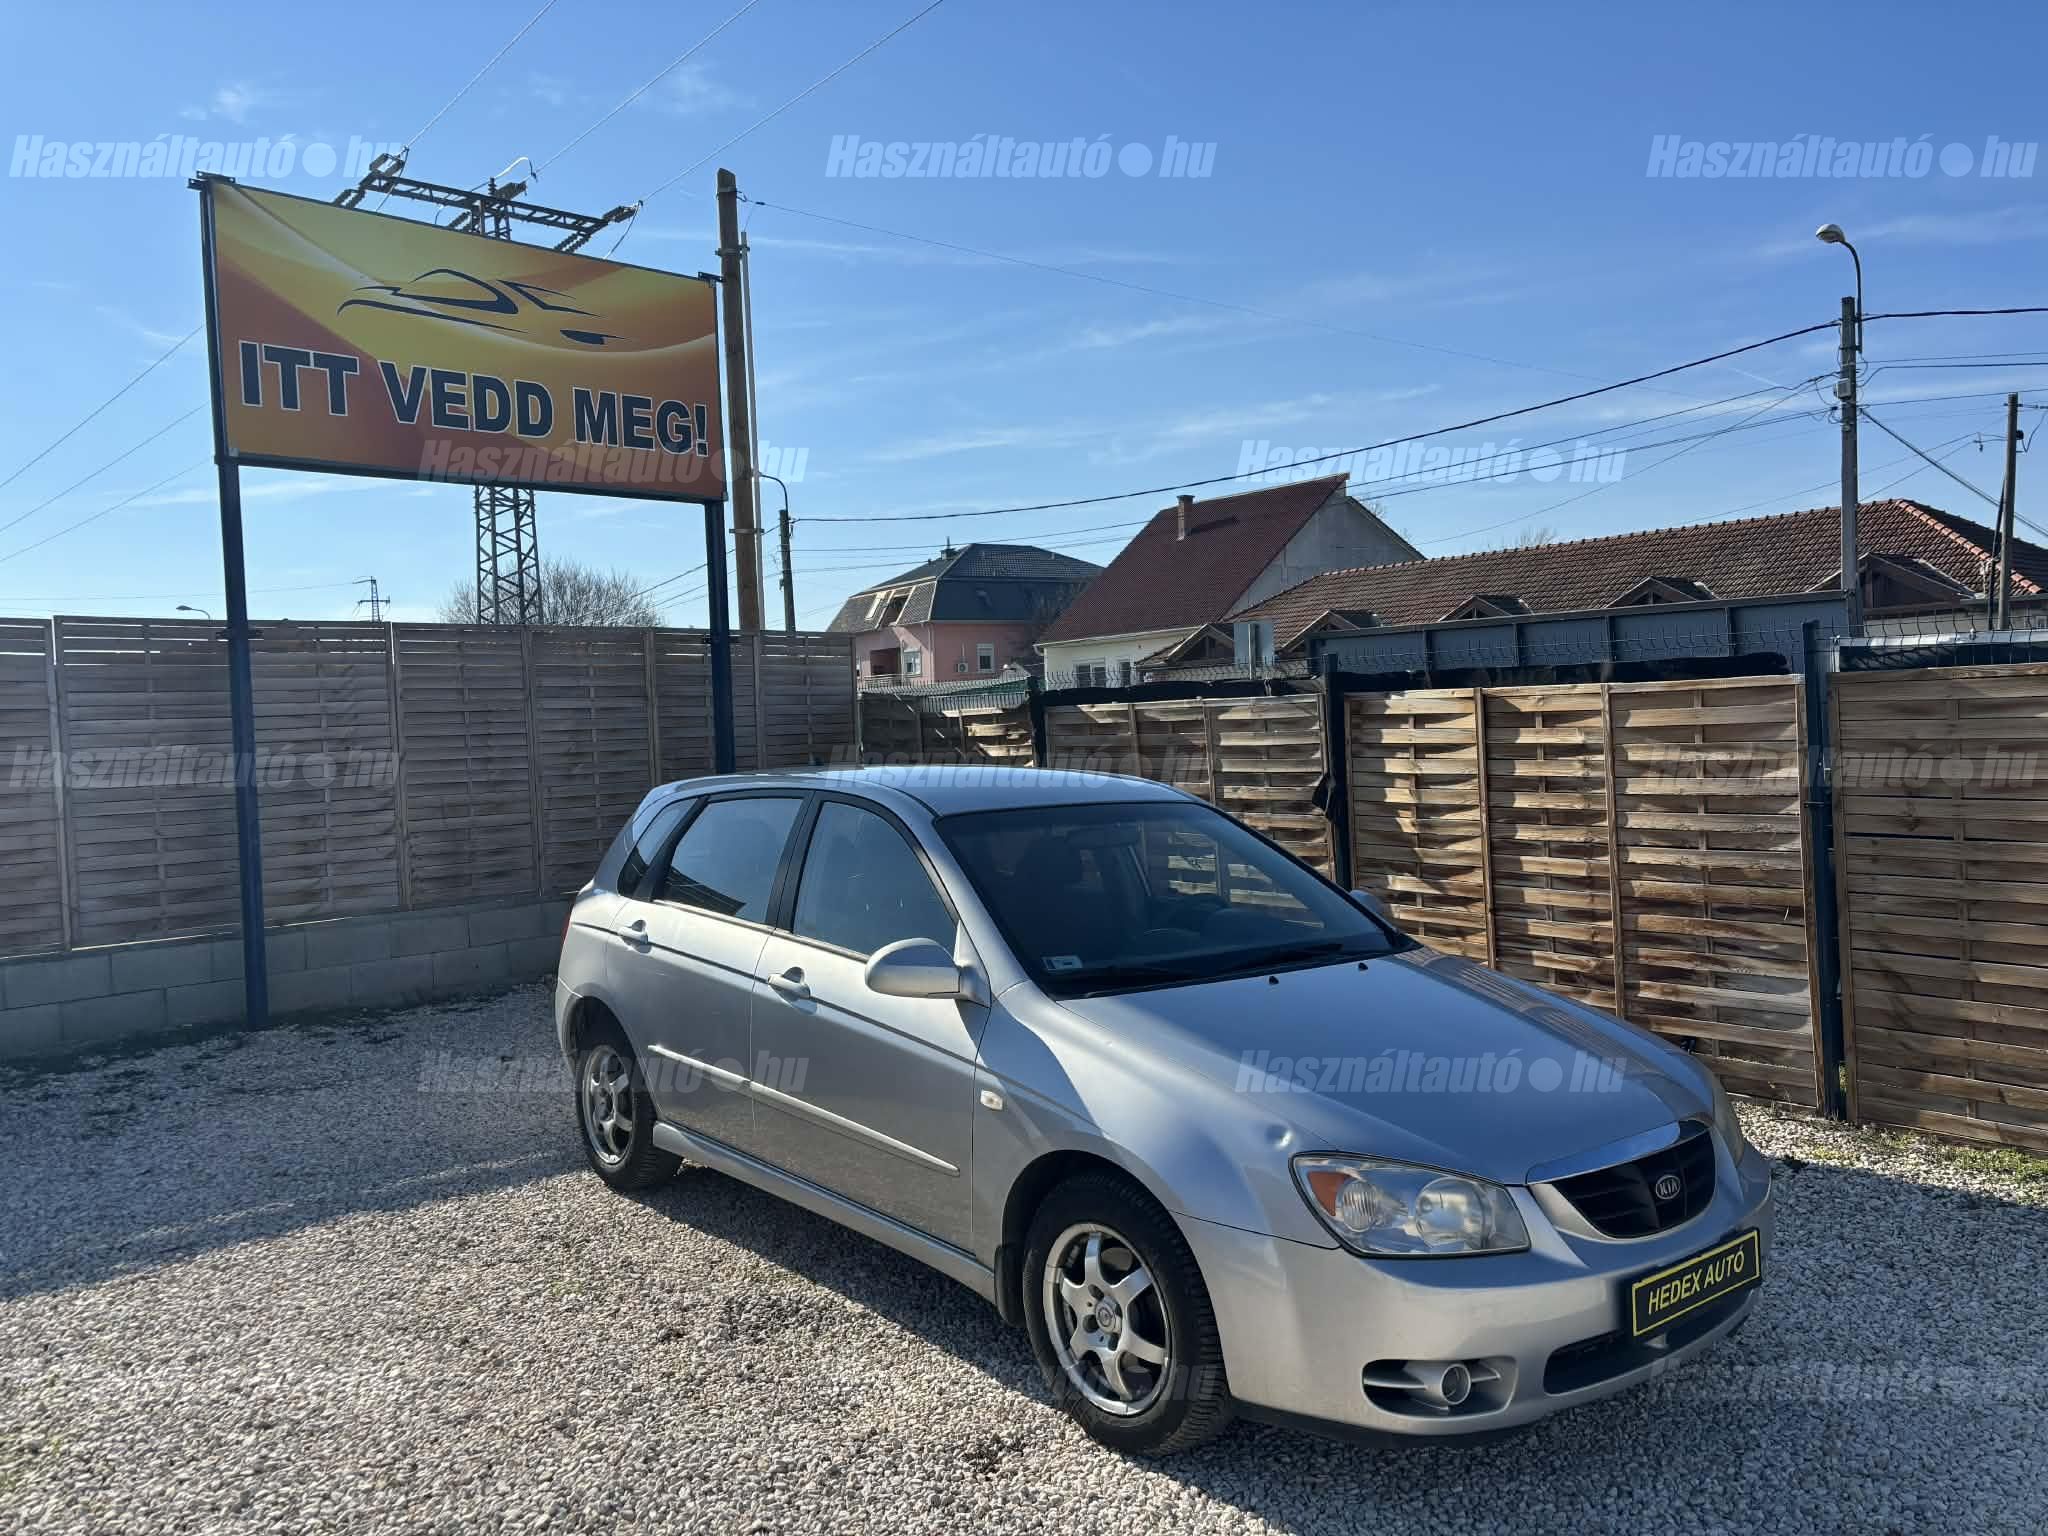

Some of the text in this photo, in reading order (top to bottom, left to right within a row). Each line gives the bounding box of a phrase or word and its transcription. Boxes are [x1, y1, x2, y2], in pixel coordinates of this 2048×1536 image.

[239, 340, 709, 457] ITT VEDD MEG!
[1658, 1178, 1679, 1197] KIA
[1648, 1245, 1745, 1315] HEDEX AUTÓ
